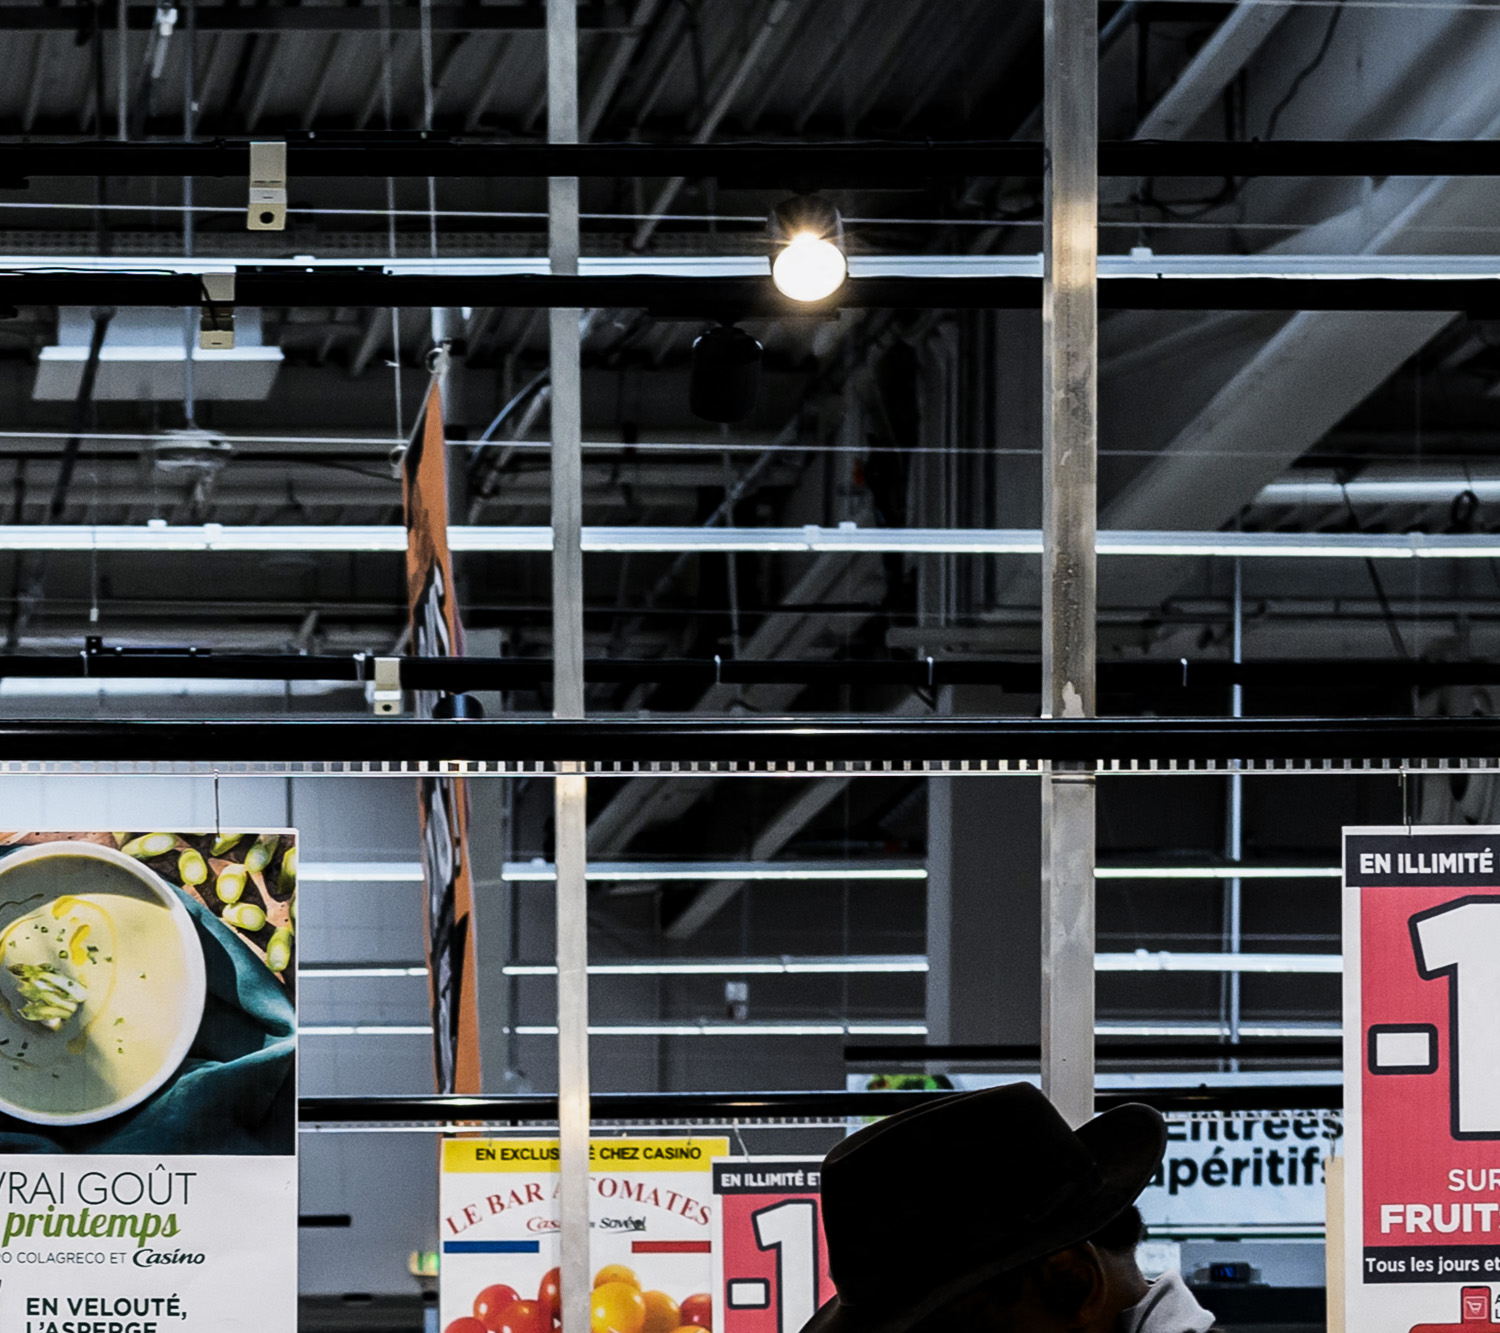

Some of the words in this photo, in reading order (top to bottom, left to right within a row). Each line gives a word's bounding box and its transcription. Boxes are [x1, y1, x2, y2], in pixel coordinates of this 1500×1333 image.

[1360, 854, 1391, 874] EN
[1398, 848, 1493, 873] ILLIMITÉ
[78, 1164, 197, 1205] GOÛT
[2, 1204, 180, 1247] printemps
[17, 1252, 104, 1264] COLAGRECO
[110, 1253, 126, 1264] ET
[133, 1248, 205, 1267] Casino
[27, 1298, 57, 1315] EN
[67, 1293, 186, 1320] VELOUTÉ,
